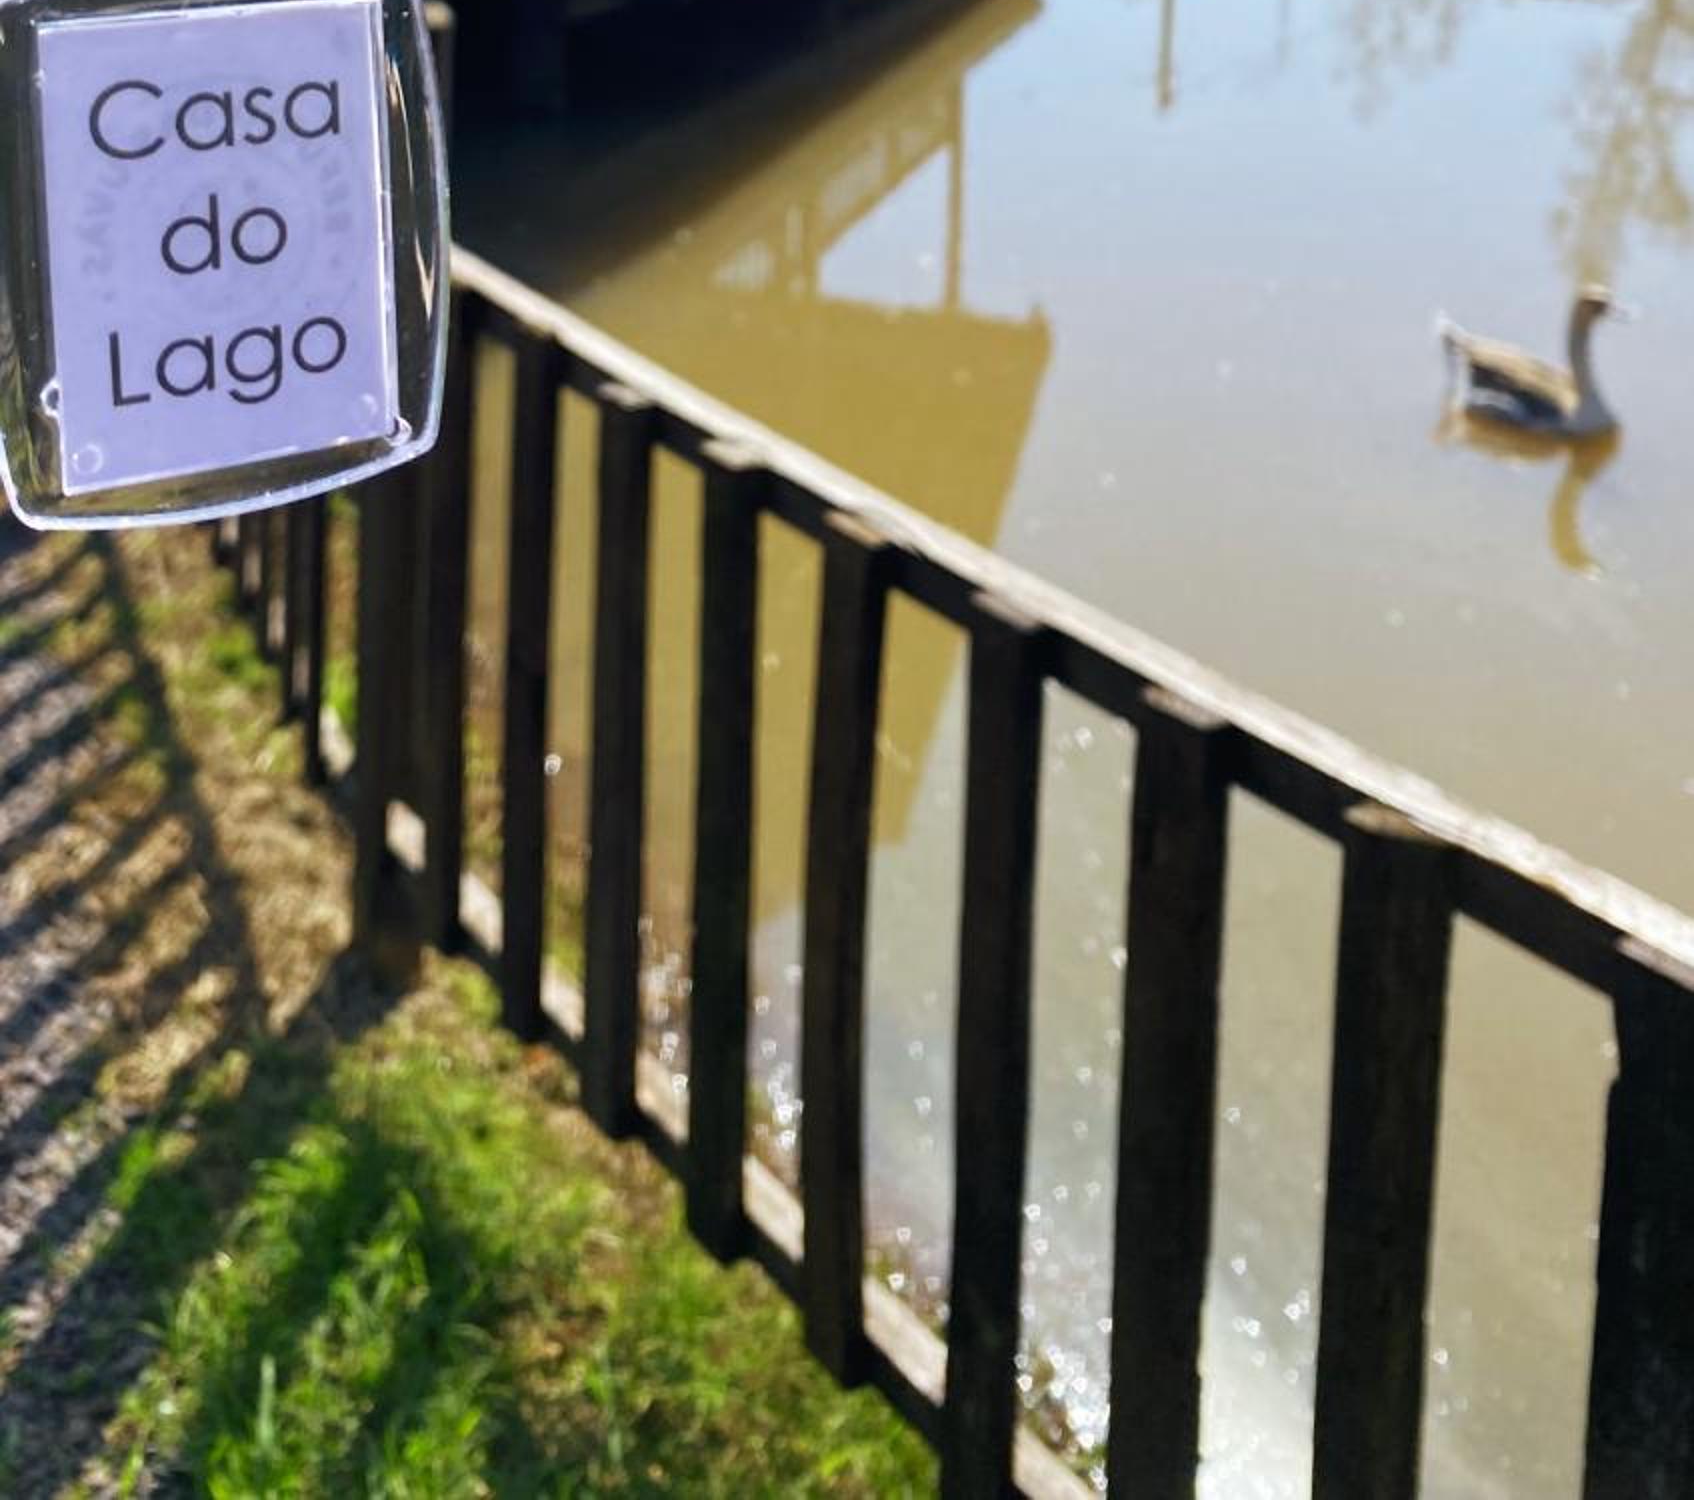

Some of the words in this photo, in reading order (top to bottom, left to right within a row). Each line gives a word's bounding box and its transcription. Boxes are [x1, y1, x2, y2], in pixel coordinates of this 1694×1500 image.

[89, 79, 341, 160] Casa
[160, 193, 288, 275] do
[108, 316, 348, 407] Lago
